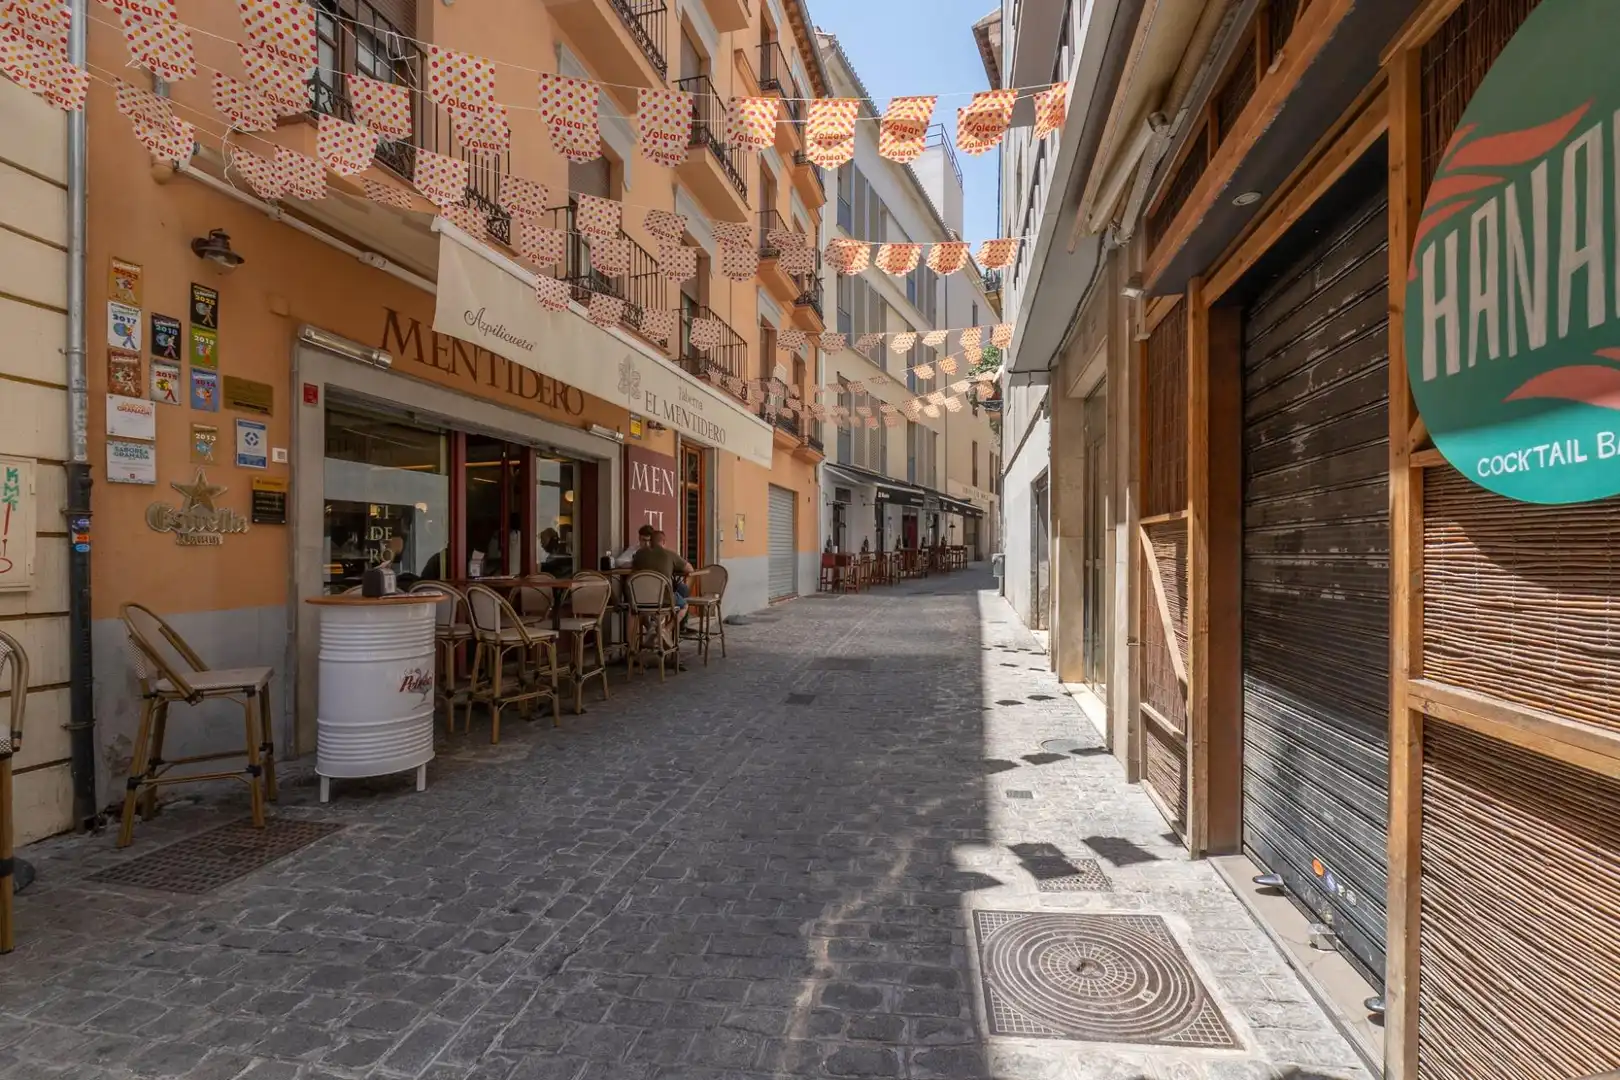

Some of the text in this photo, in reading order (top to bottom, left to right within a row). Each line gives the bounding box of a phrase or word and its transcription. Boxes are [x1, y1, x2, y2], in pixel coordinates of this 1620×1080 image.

[6, 2, 58, 26] Solear
[97, 0, 164, 18] olear
[258, 40, 307, 65] Solear
[140, 53, 187, 74] Solear
[4, 65, 56, 90] Solear
[260, 90, 301, 109] Solear
[438, 94, 484, 114] Solear
[223, 107, 267, 129] Solear
[547, 115, 588, 131] Solear
[367, 119, 404, 135] Solear
[644, 129, 683, 142] Solear
[888, 122, 920, 136] Solear
[970, 122, 1001, 132] Solear
[464, 138, 501, 151] Solear
[731, 131, 766, 144] Solear
[141, 136, 181, 157] Solear
[560, 146, 595, 157] Solear
[324, 152, 362, 170] Solear
[649, 150, 682, 161] Solear
[283, 180, 319, 197] Solear
[421, 184, 457, 199] Solear
[505, 202, 537, 217] Solear
[582, 224, 612, 237] Solear
[649, 225, 675, 239] Solear
[1422, 108, 1620, 382] HANA
[596, 263, 624, 273] Solear
[112, 313, 137, 325] 2017
[463, 307, 534, 351] Azpilicueta
[378, 306, 585, 417] MENTIDERO
[645, 390, 661, 416] EL
[663, 401, 726, 446] MENTIDERO
[1477, 431, 1620, 478] COCKTAIL B
[631, 461, 675, 498] MEN
[370, 526, 393, 541] DE
